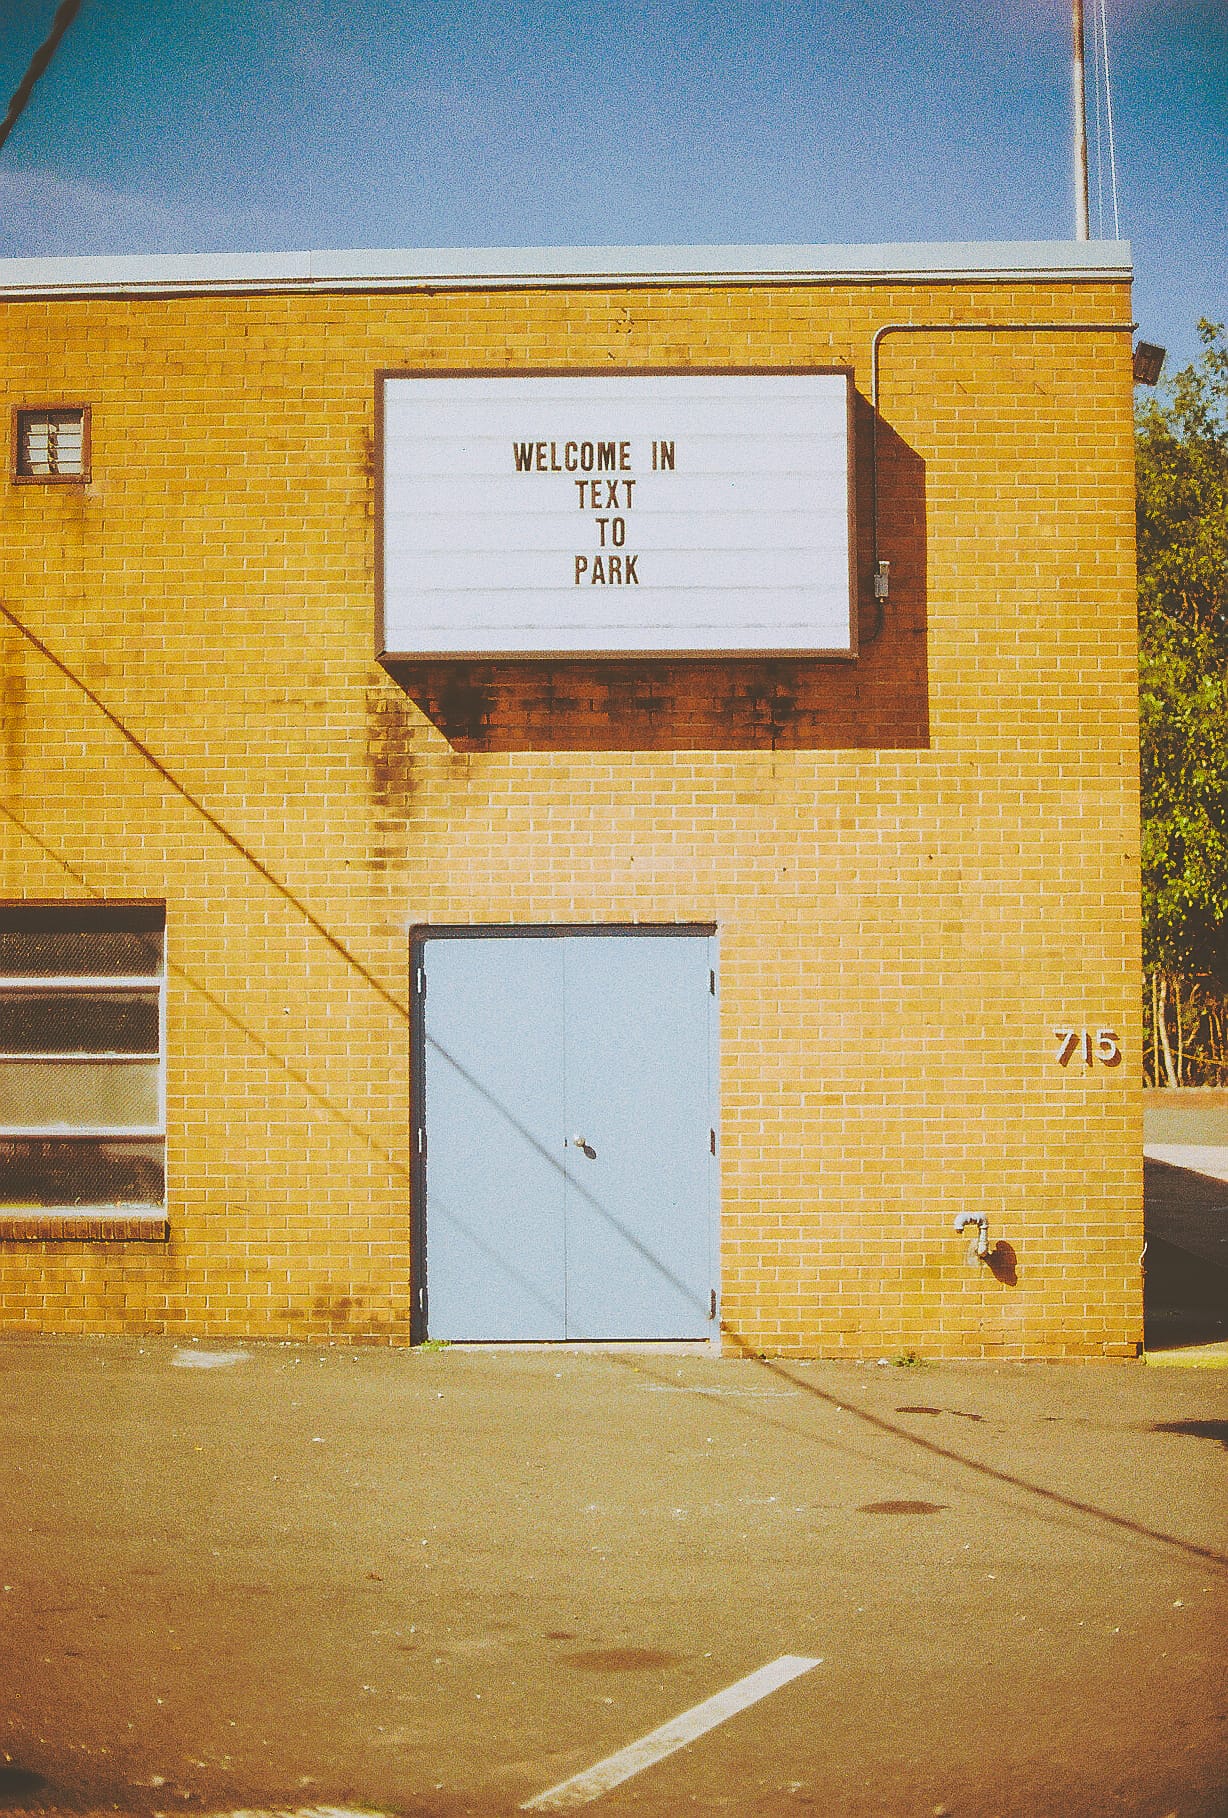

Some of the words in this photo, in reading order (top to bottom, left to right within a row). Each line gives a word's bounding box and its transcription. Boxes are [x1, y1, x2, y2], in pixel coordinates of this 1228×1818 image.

[513, 441, 632, 472] WELCOME
[652, 441, 676, 471] IN
[574, 479, 636, 509] TEXT
[595, 517, 626, 547] TO
[574, 554, 639, 584] PARK
[1053, 1028, 1117, 1062] 715
